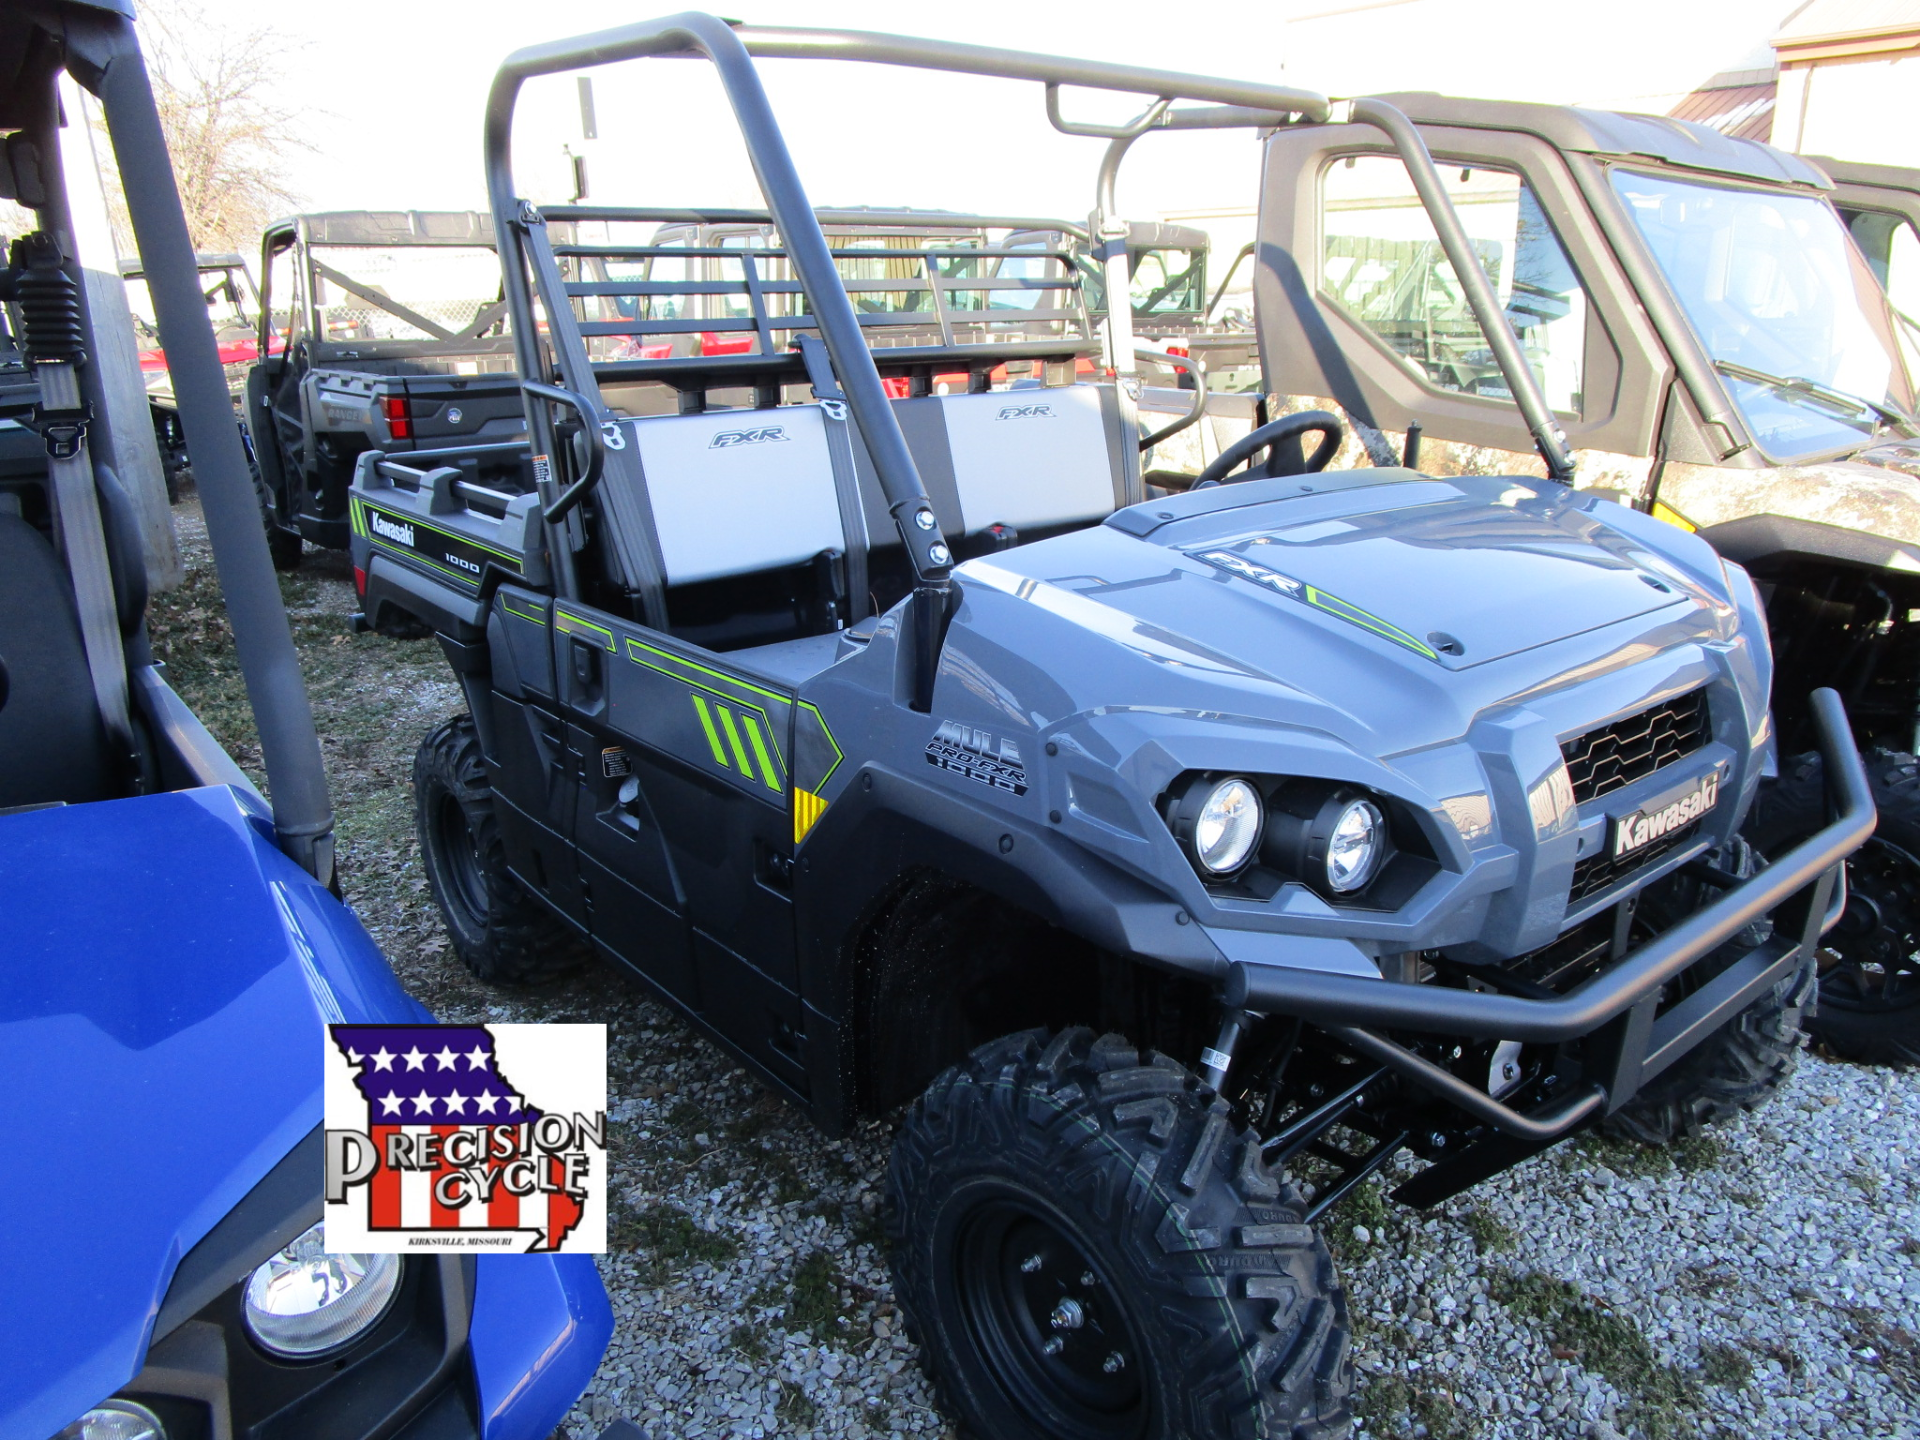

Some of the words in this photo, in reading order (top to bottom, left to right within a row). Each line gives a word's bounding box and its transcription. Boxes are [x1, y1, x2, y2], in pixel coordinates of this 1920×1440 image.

[996, 404, 1055, 420] FXR
[709, 426, 789, 448] FXR
[372, 511, 414, 547] Kawasaki
[445, 553, 479, 573] 1000
[1198, 551, 1301, 597] FXR
[932, 720, 1024, 770] MULE
[925, 742, 1027, 785] PRO-FXR
[938, 758, 1015, 793] 1000
[1615, 774, 1717, 856] Kawasaki
